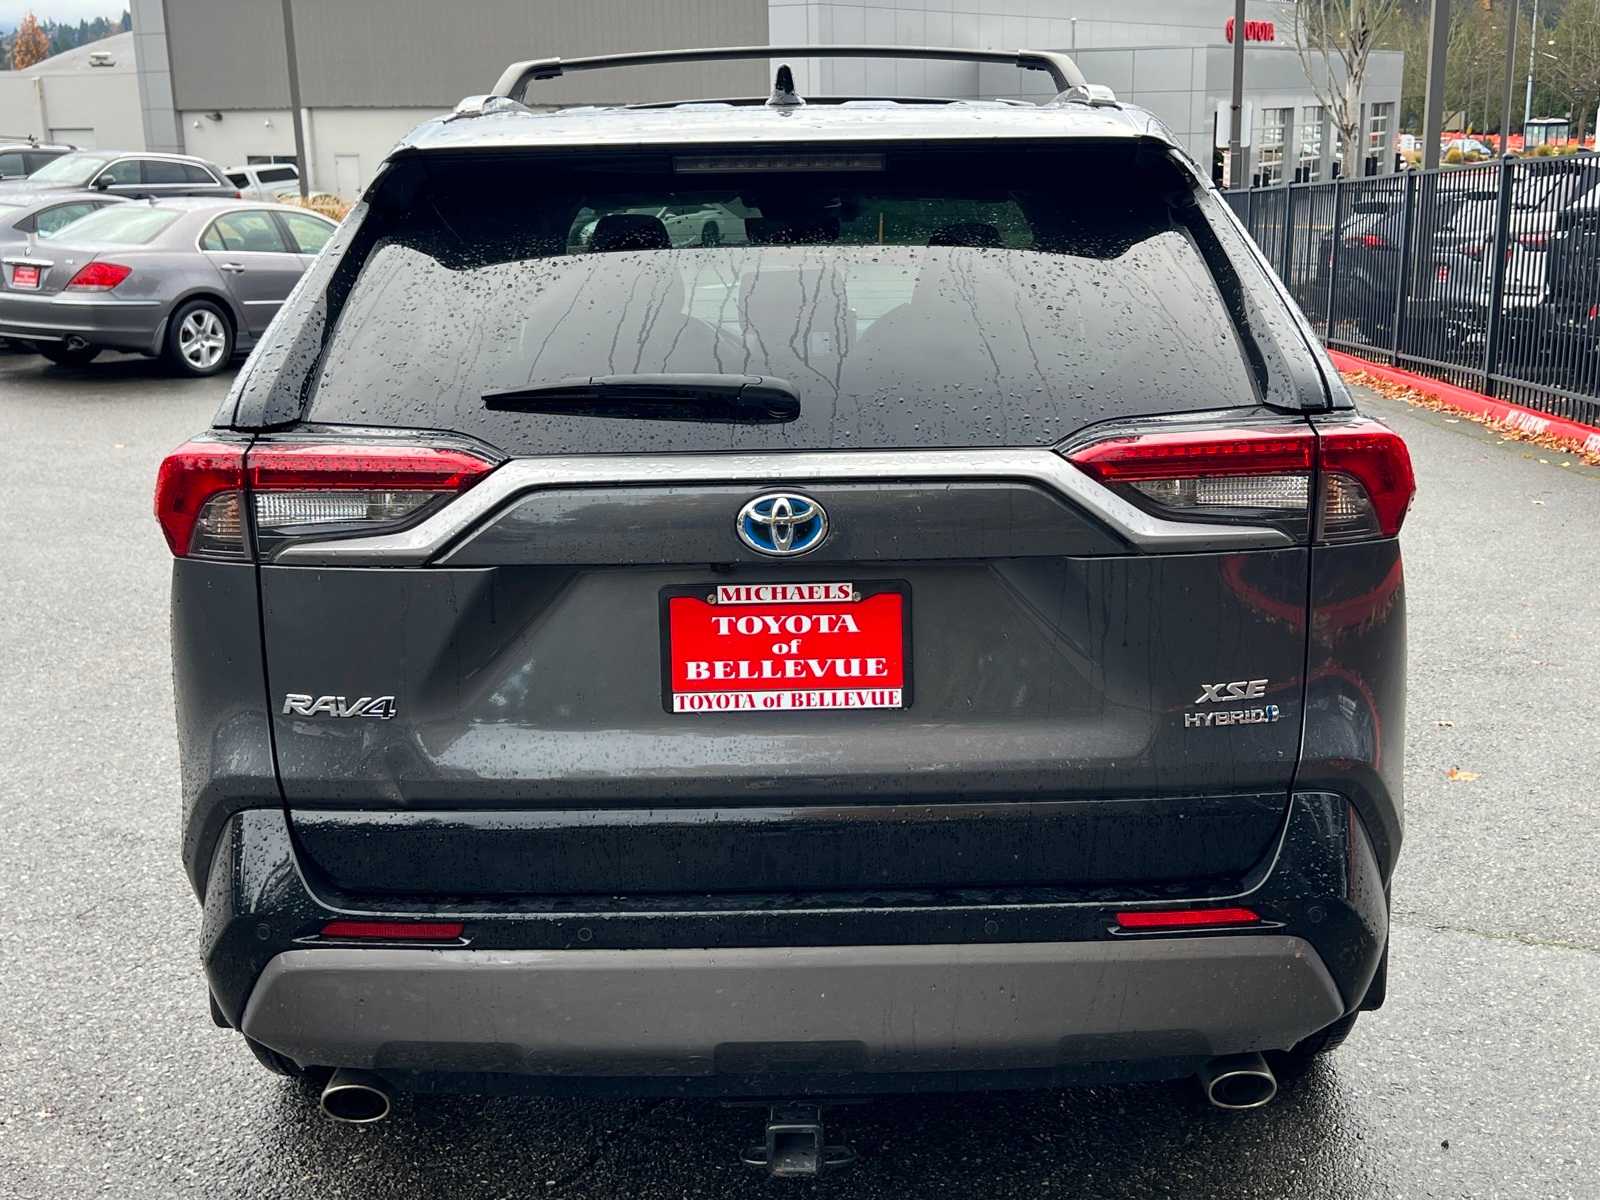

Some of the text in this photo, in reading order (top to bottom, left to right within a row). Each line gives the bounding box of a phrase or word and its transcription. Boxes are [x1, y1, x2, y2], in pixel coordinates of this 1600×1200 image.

[720, 585, 851, 602] MICHAELS
[711, 614, 861, 636] TOYOTA
[771, 639, 802, 655] of
[685, 657, 889, 681] BELLEVUE
[675, 690, 901, 711] TOYOTA of BELLEVUE
[1194, 679, 1269, 704] XSE
[282, 693, 397, 720] RAV4
[1184, 709, 1265, 728] HYBRID
